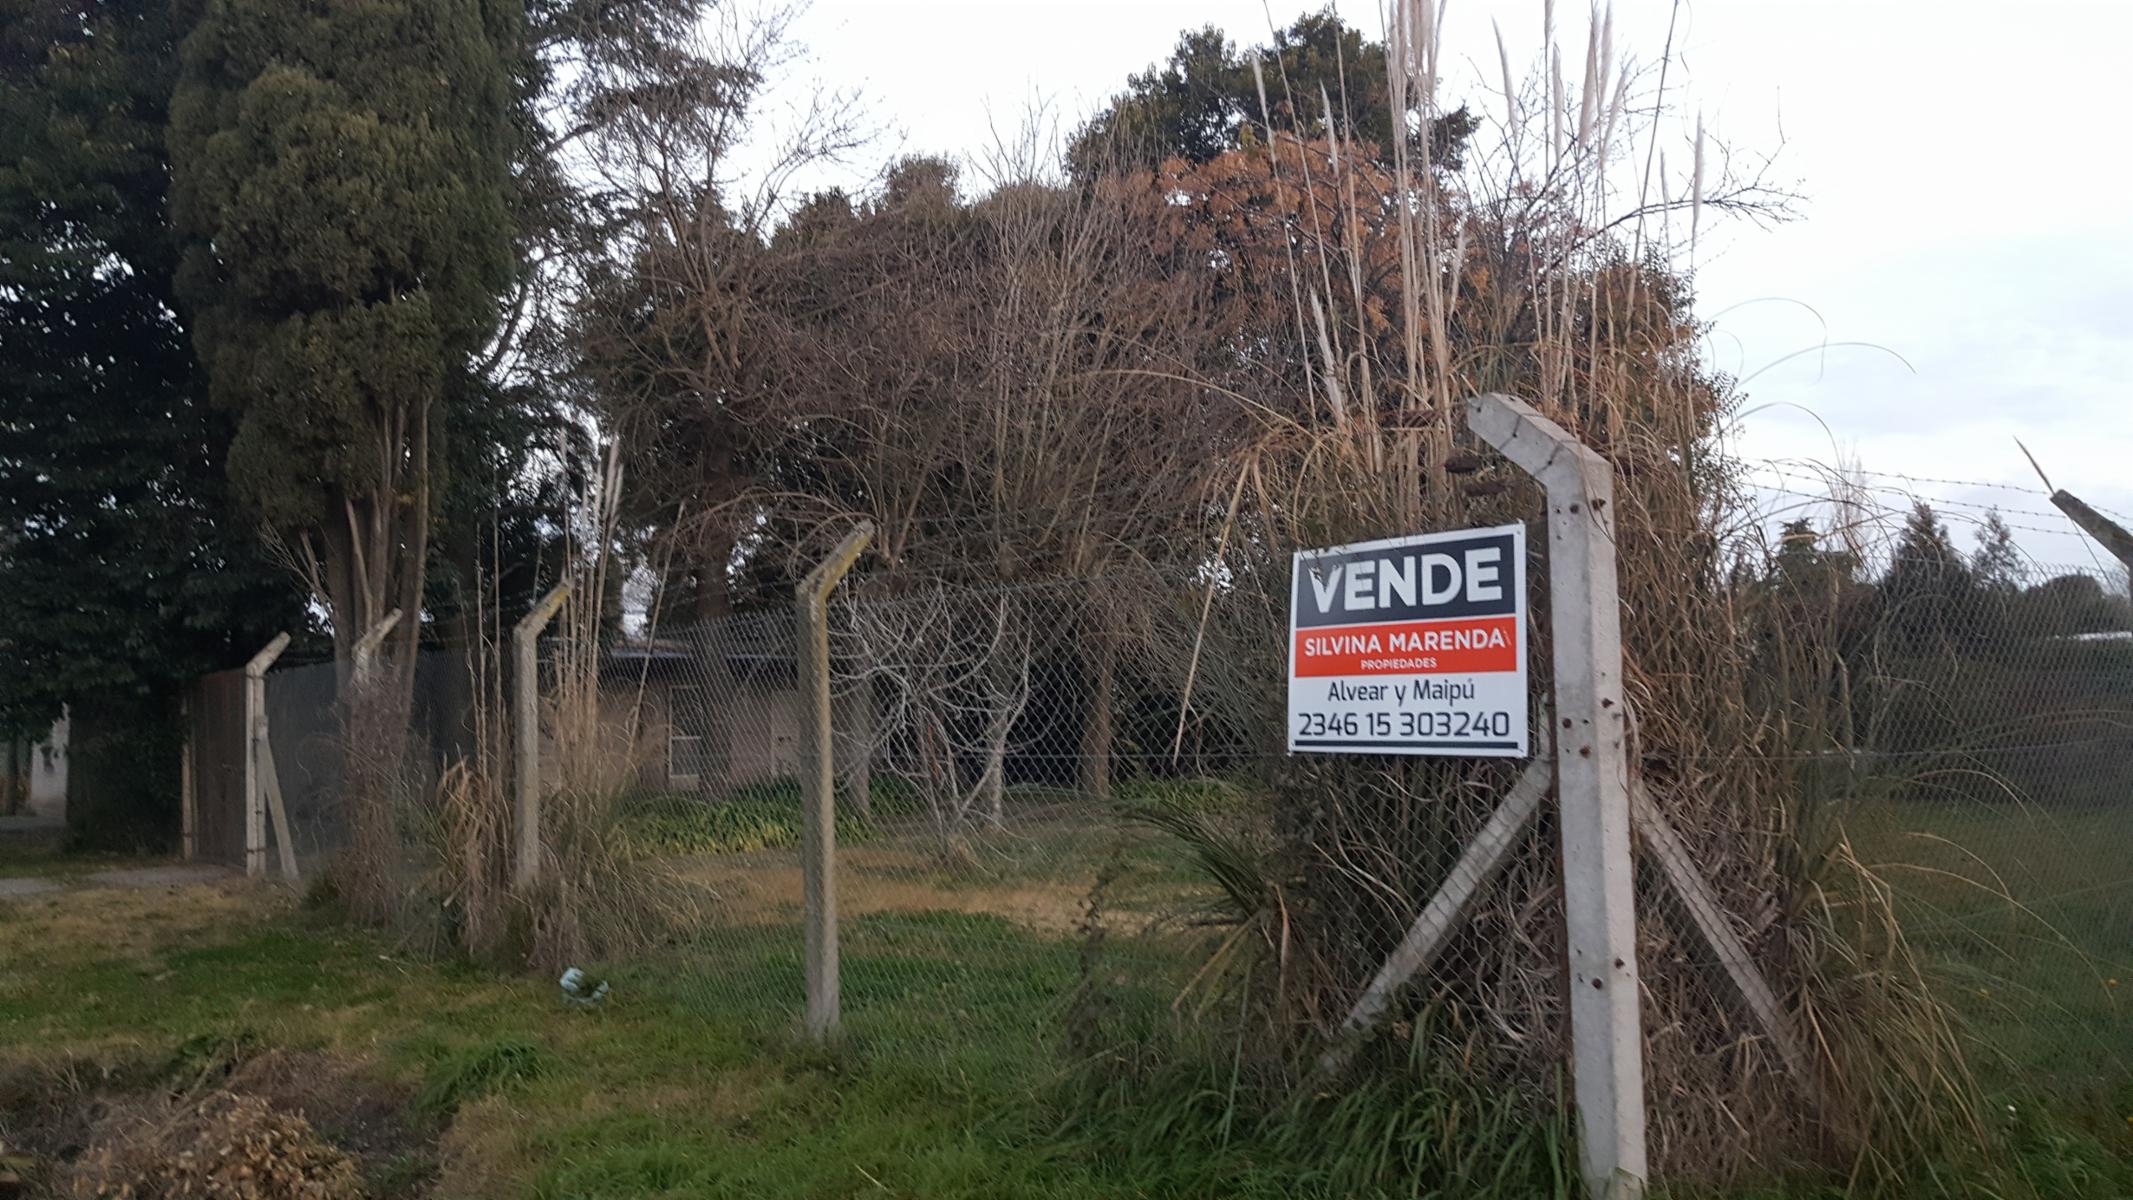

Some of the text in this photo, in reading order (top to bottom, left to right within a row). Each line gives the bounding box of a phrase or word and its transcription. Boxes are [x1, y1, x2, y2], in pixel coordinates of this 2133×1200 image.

[1308, 547, 1502, 613] VENDE
[1304, 633, 1382, 656] SILVINA
[1389, 628, 1505, 652] MARENDA
[1361, 657, 1437, 670] PROPIEDADES
[1328, 678, 1474, 707] Alvear y Maipú
[1299, 711, 1509, 737] 2346 15 303240
